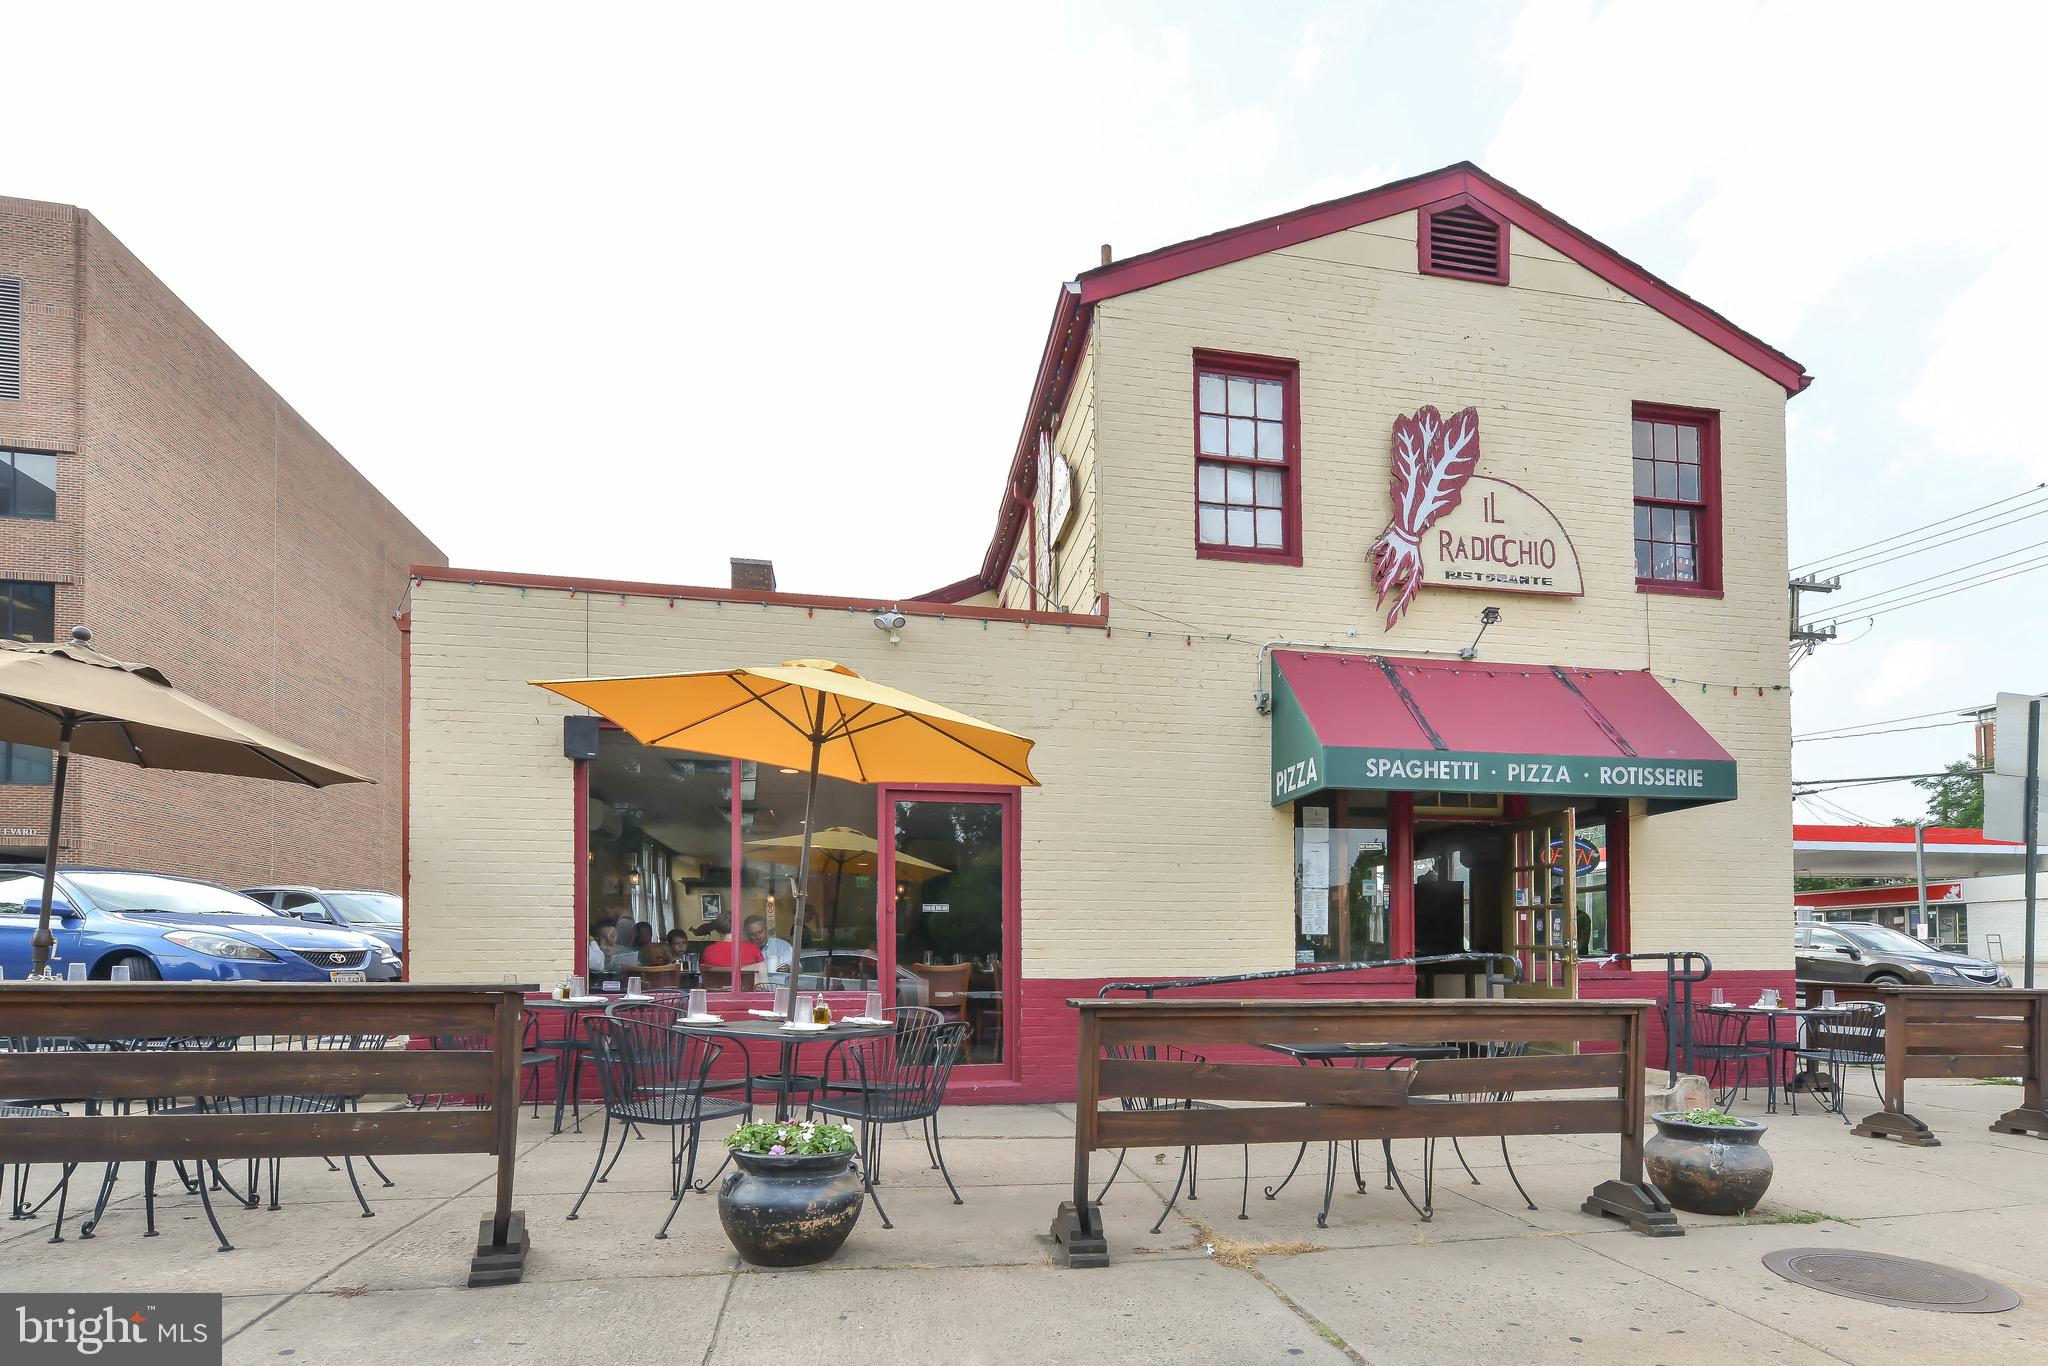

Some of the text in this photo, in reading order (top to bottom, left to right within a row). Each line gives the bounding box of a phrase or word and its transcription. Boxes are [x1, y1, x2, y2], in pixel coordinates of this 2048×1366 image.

[1483, 492, 1505, 523] IL
[1439, 530, 1556, 569] RADICCHIO
[1445, 571, 1553, 586] RISTORANTE
[1276, 757, 1318, 796] PIZZA
[1366, 757, 1703, 787] SPAGHETTI PIZZA ROTISSERIE
